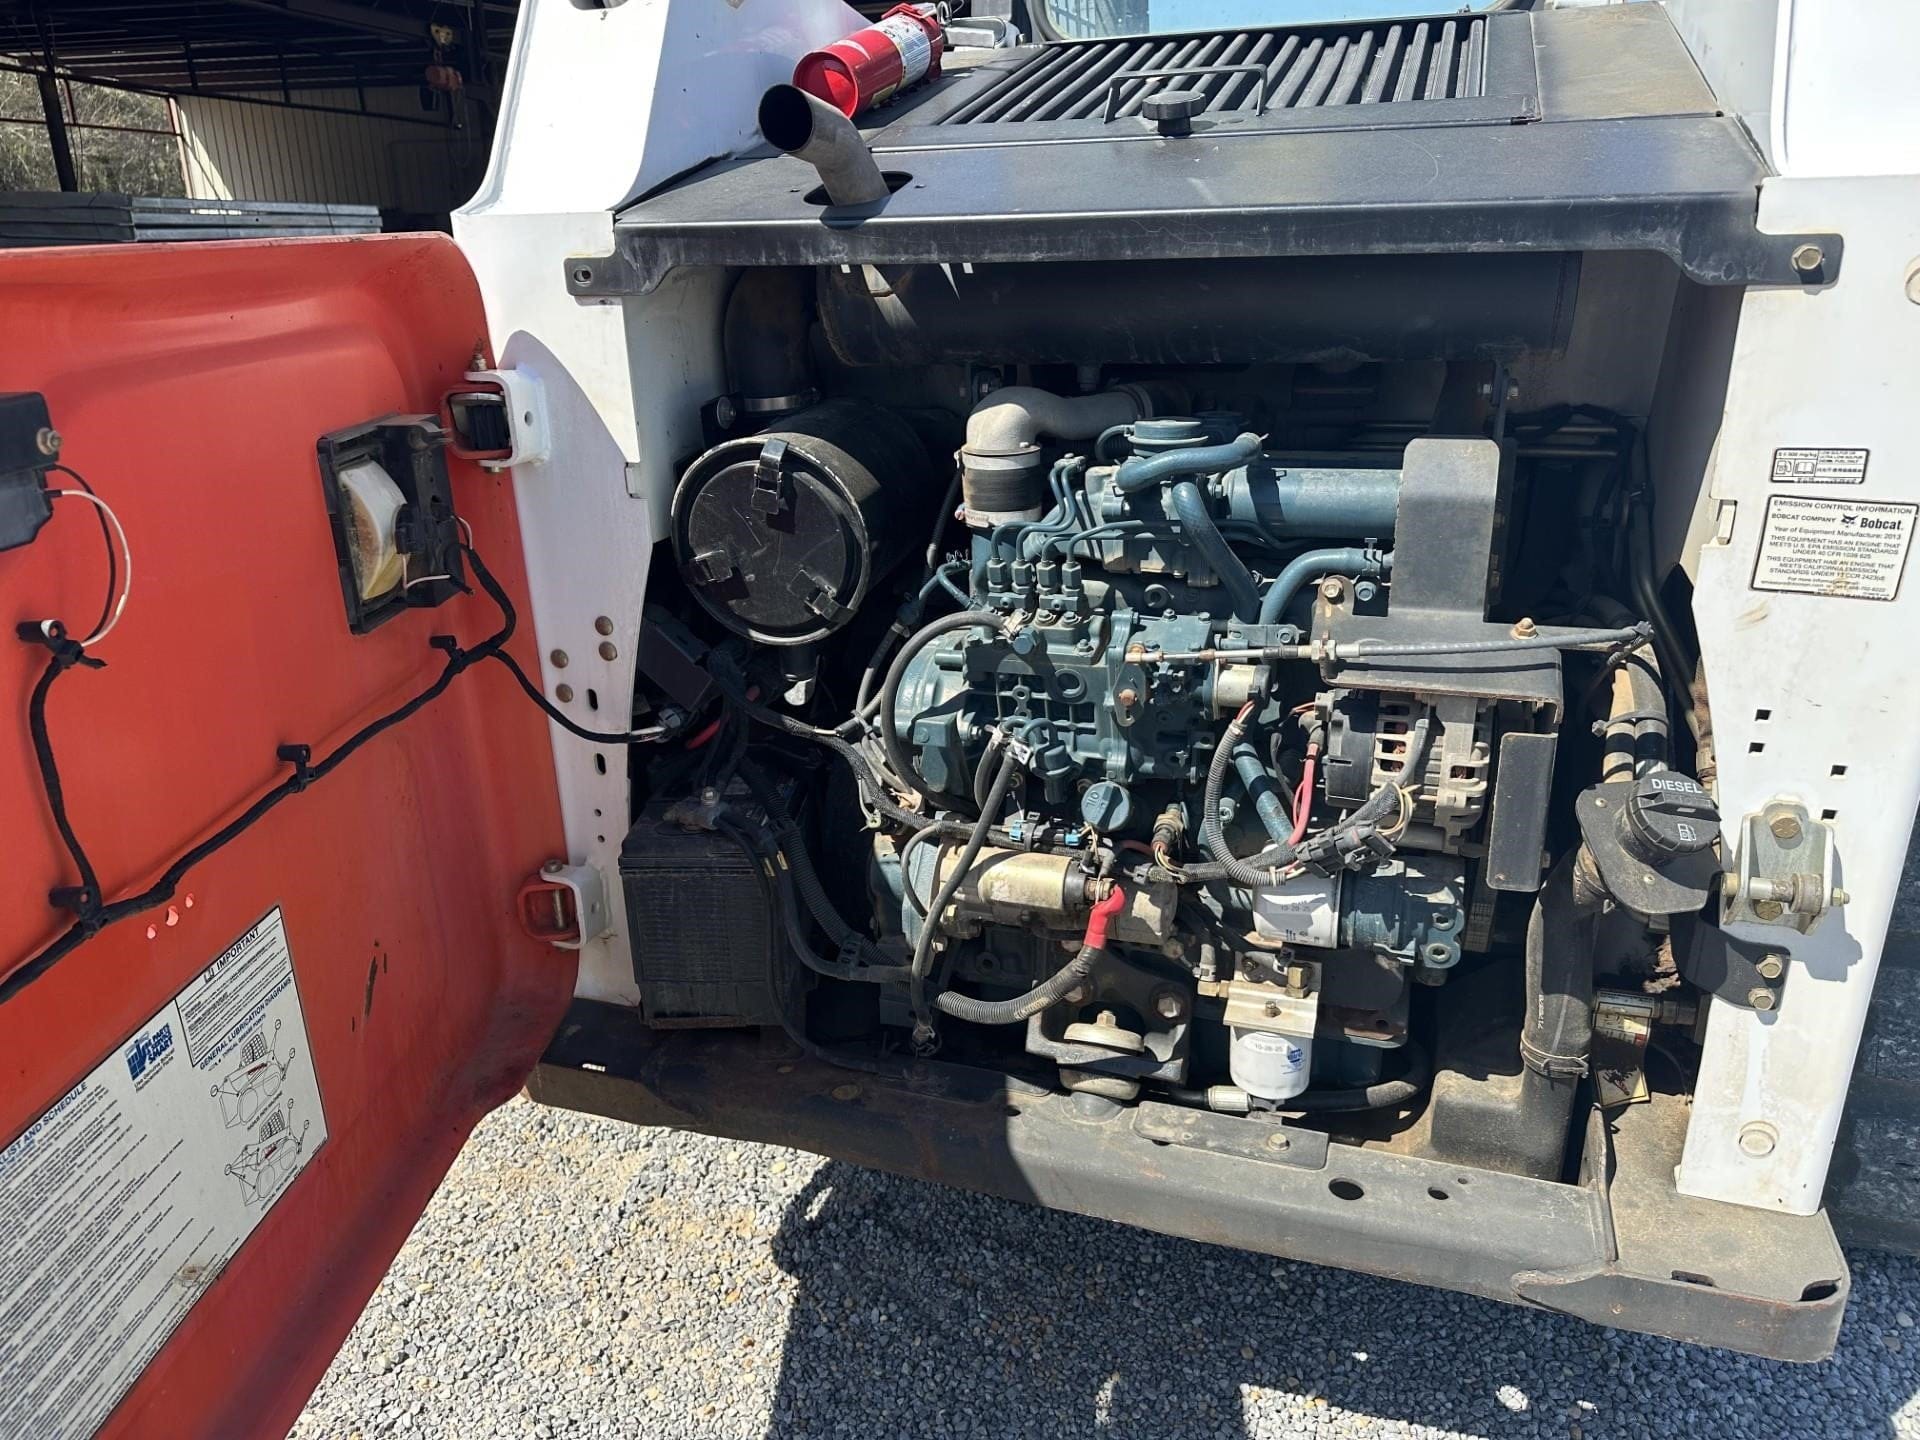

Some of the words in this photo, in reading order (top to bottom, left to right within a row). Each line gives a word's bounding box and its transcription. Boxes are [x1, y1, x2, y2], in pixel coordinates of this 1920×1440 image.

[1774, 500, 1812, 508] EMISSION
[1814, 502, 1853, 512] CONTROL
[1856, 504, 1912, 514] INFORMATION
[1860, 517, 1902, 530] Bobcat
[1786, 536, 1827, 544] EQUIPMENT
[1798, 528, 1835, 536] Equipment
[1651, 778, 1703, 794] DIESEL
[216, 926, 260, 970] IMPORTANT
[200, 1041, 228, 1070] GENERAL
[228, 1004, 265, 1042] LUBRICATION
[265, 976, 292, 1006] DIAGRAMS
[148, 1036, 172, 1064] SMART
[24, 1122, 42, 1143] AND
[42, 1082, 88, 1126] SCHEDULE
